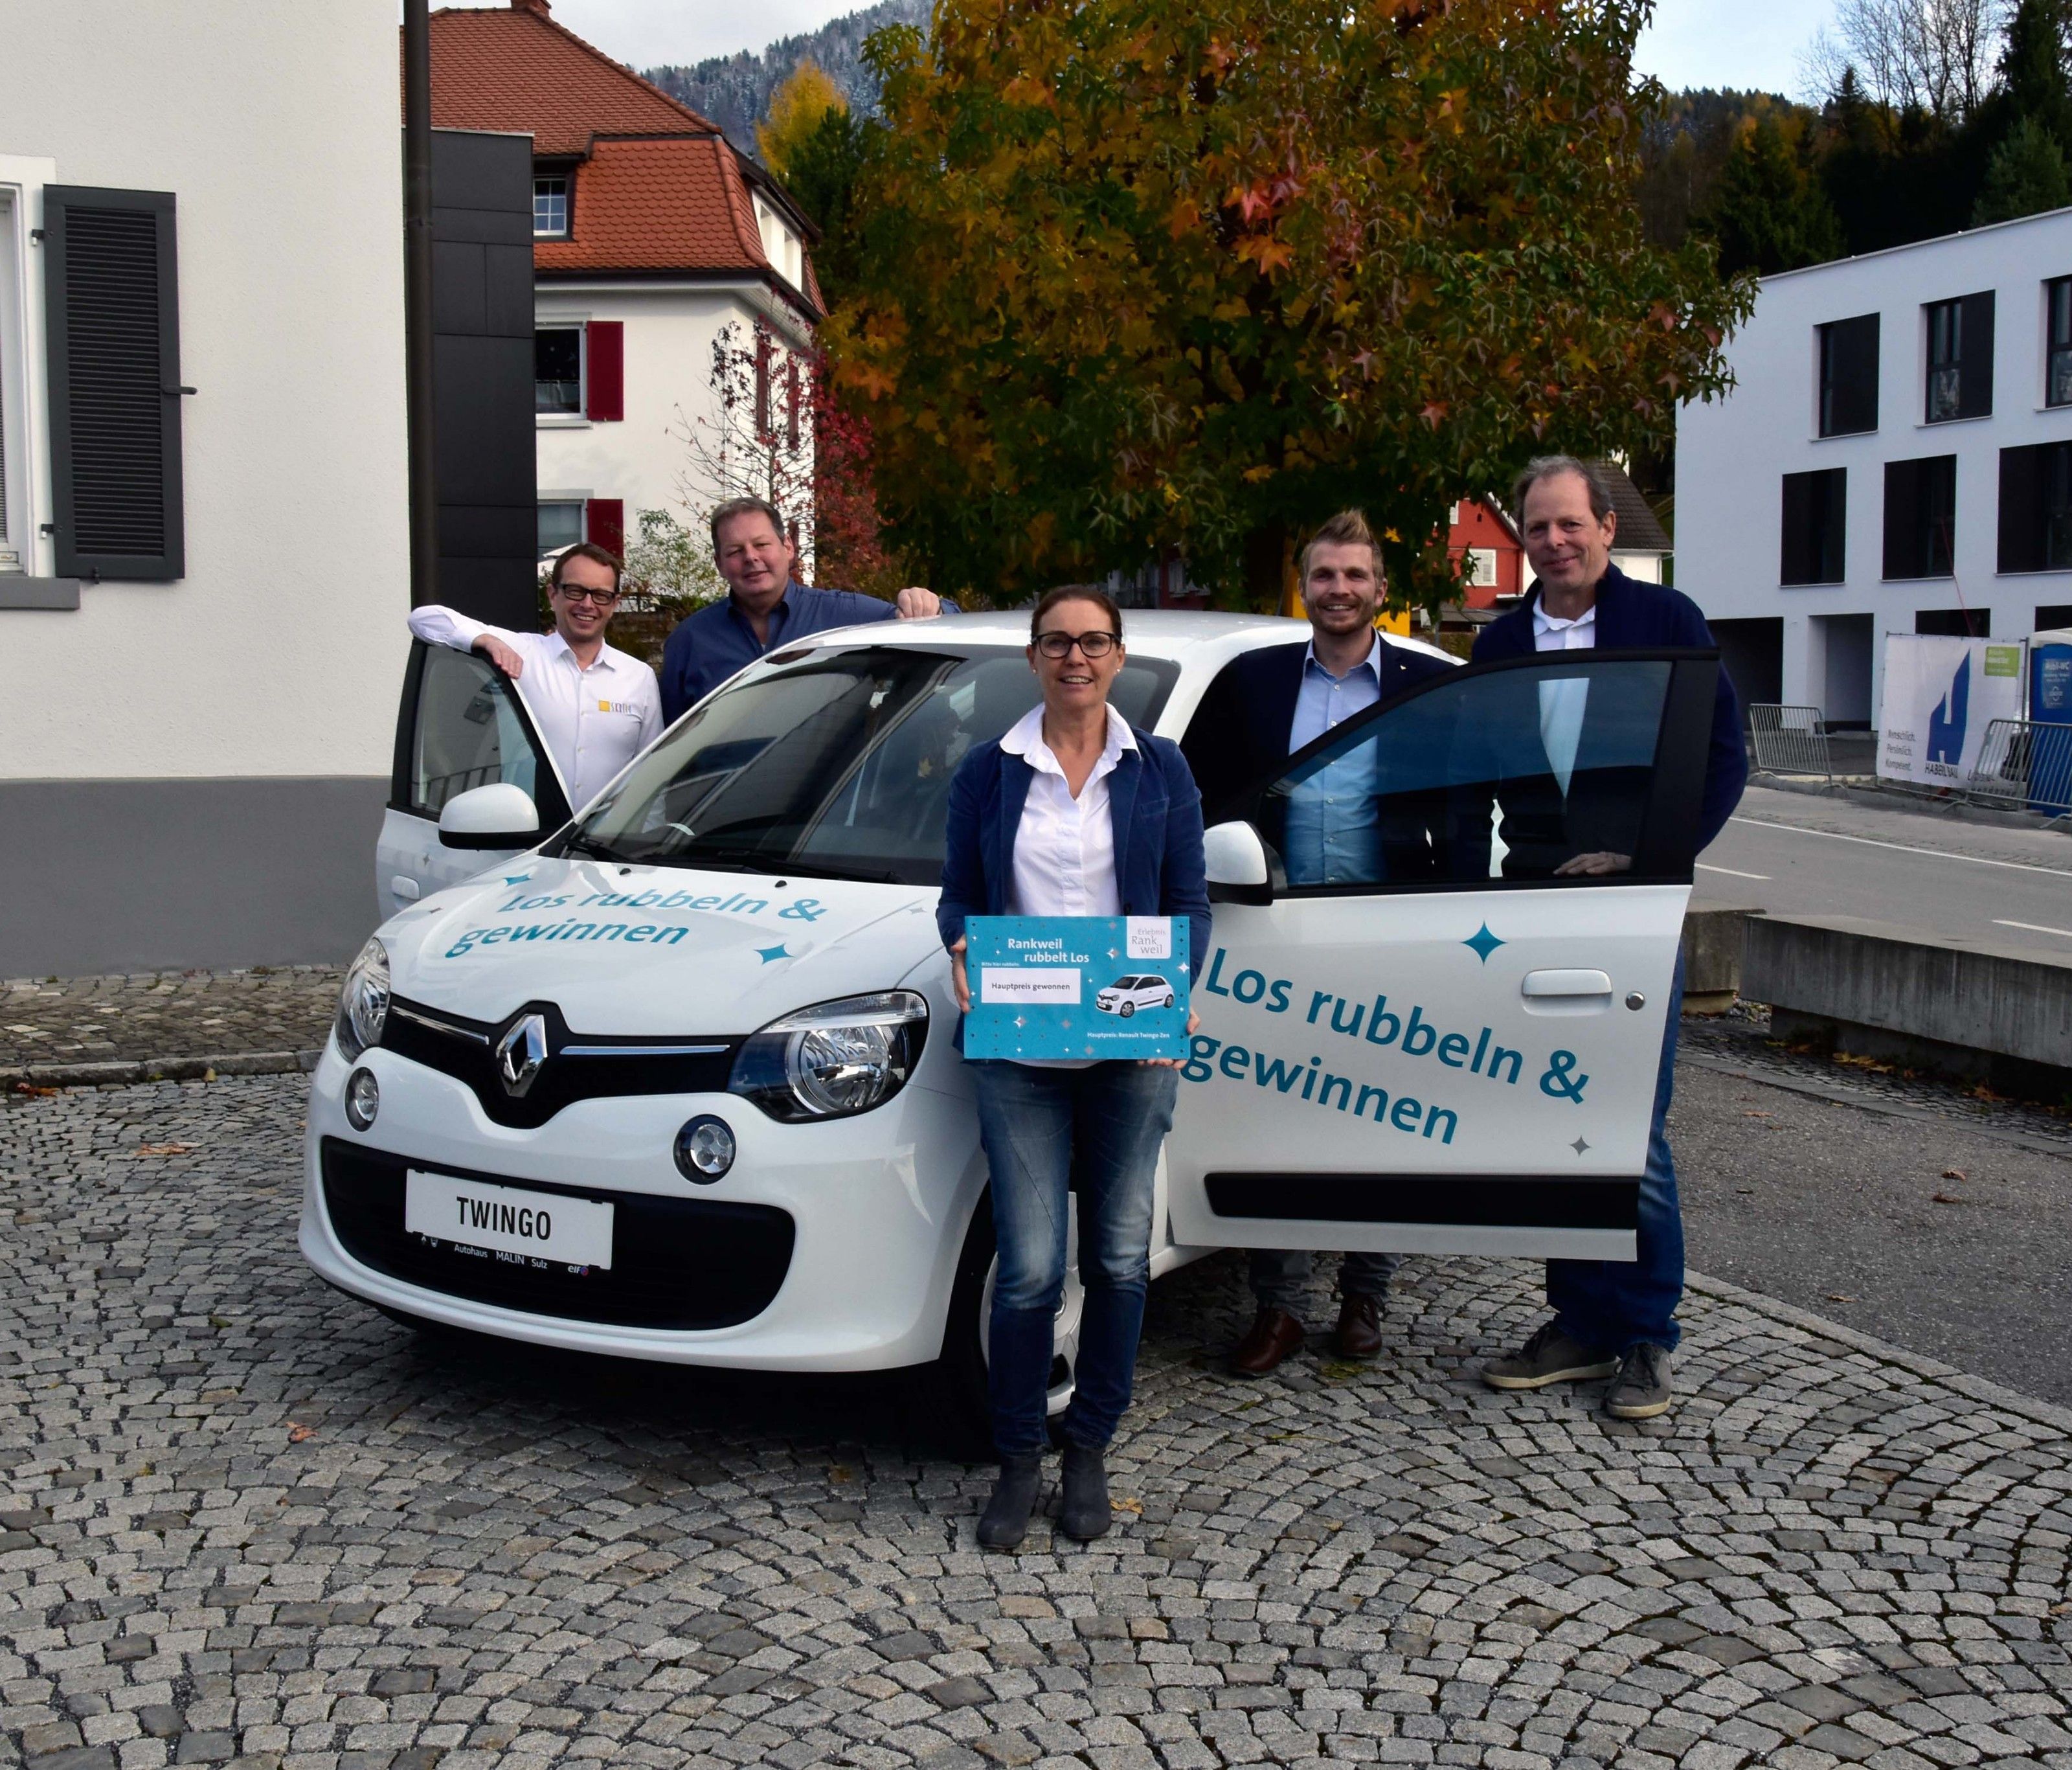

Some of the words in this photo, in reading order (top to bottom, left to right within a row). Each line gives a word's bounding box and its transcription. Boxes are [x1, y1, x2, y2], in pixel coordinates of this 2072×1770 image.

[497, 895, 575, 912] Los
[578, 889, 769, 914] rubbeln
[778, 898, 828, 922] &
[445, 918, 690, 959] gewinnen
[1008, 938, 1063, 949] Rankweil
[1131, 935, 1157, 945] Rank
[1140, 944, 1162, 954] weil
[1024, 951, 1068, 963] rubbelt
[1070, 953, 1090, 963] Los
[991, 982, 1031, 992] Hauptpreis
[1032, 983, 1070, 992] gewonnen
[1205, 948, 1293, 1013] Los
[1306, 991, 1523, 1084] rubbeln
[1538, 1050, 1590, 1105] &
[1180, 1034, 1459, 1145] gewinnen
[456, 1196, 552, 1240] TWINGO
[455, 1243, 488, 1258] Autohaus
[495, 1251, 525, 1265] MALIN
[532, 1258, 548, 1269] Sulz
[568, 1264, 581, 1274] elf
